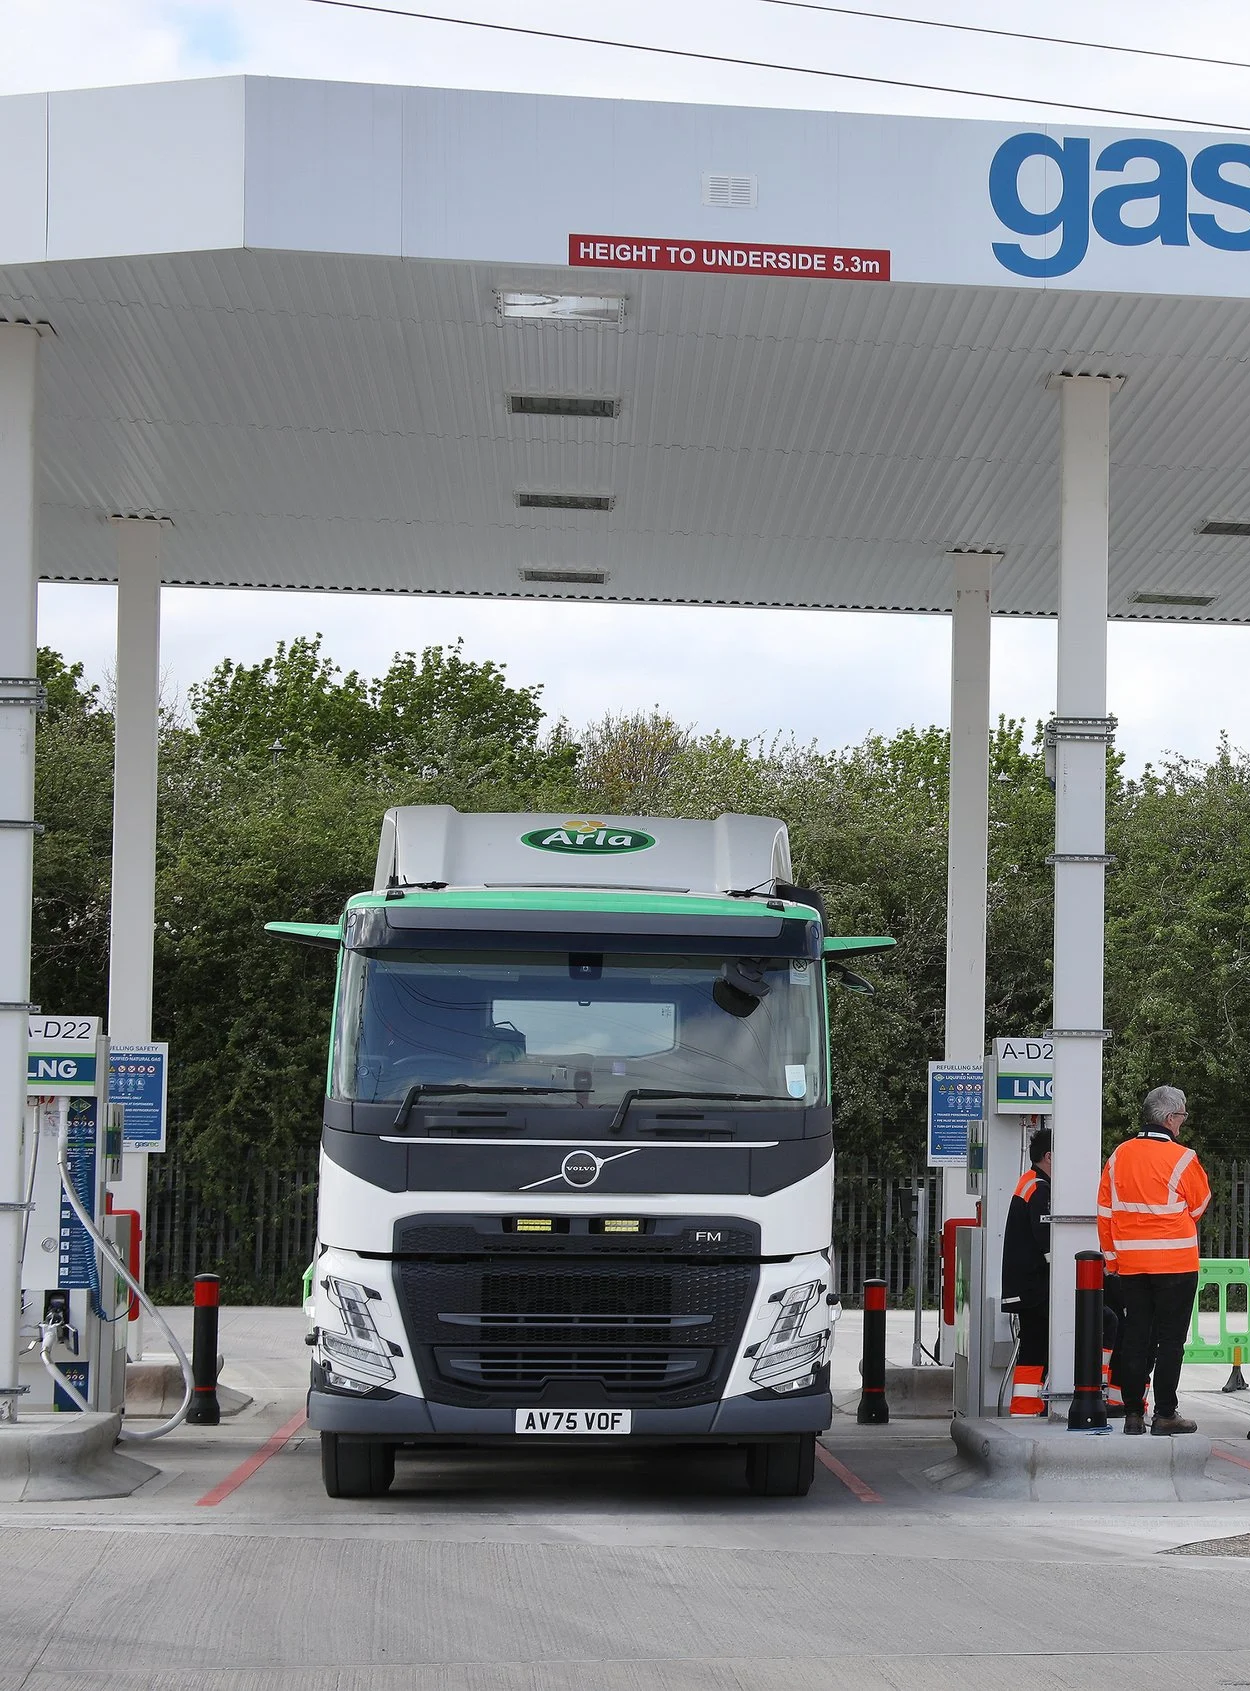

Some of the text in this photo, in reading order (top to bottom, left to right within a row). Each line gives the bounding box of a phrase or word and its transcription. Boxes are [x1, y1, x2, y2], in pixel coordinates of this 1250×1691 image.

[579, 241, 880, 273] HEIGHT TO UNDERSIDE 5.3m
[541, 830, 633, 846] Arla
[134, 1141, 159, 1149] gasrec
[695, 1231, 722, 1242] FM
[525, 1412, 623, 1430] AV75 VOF
